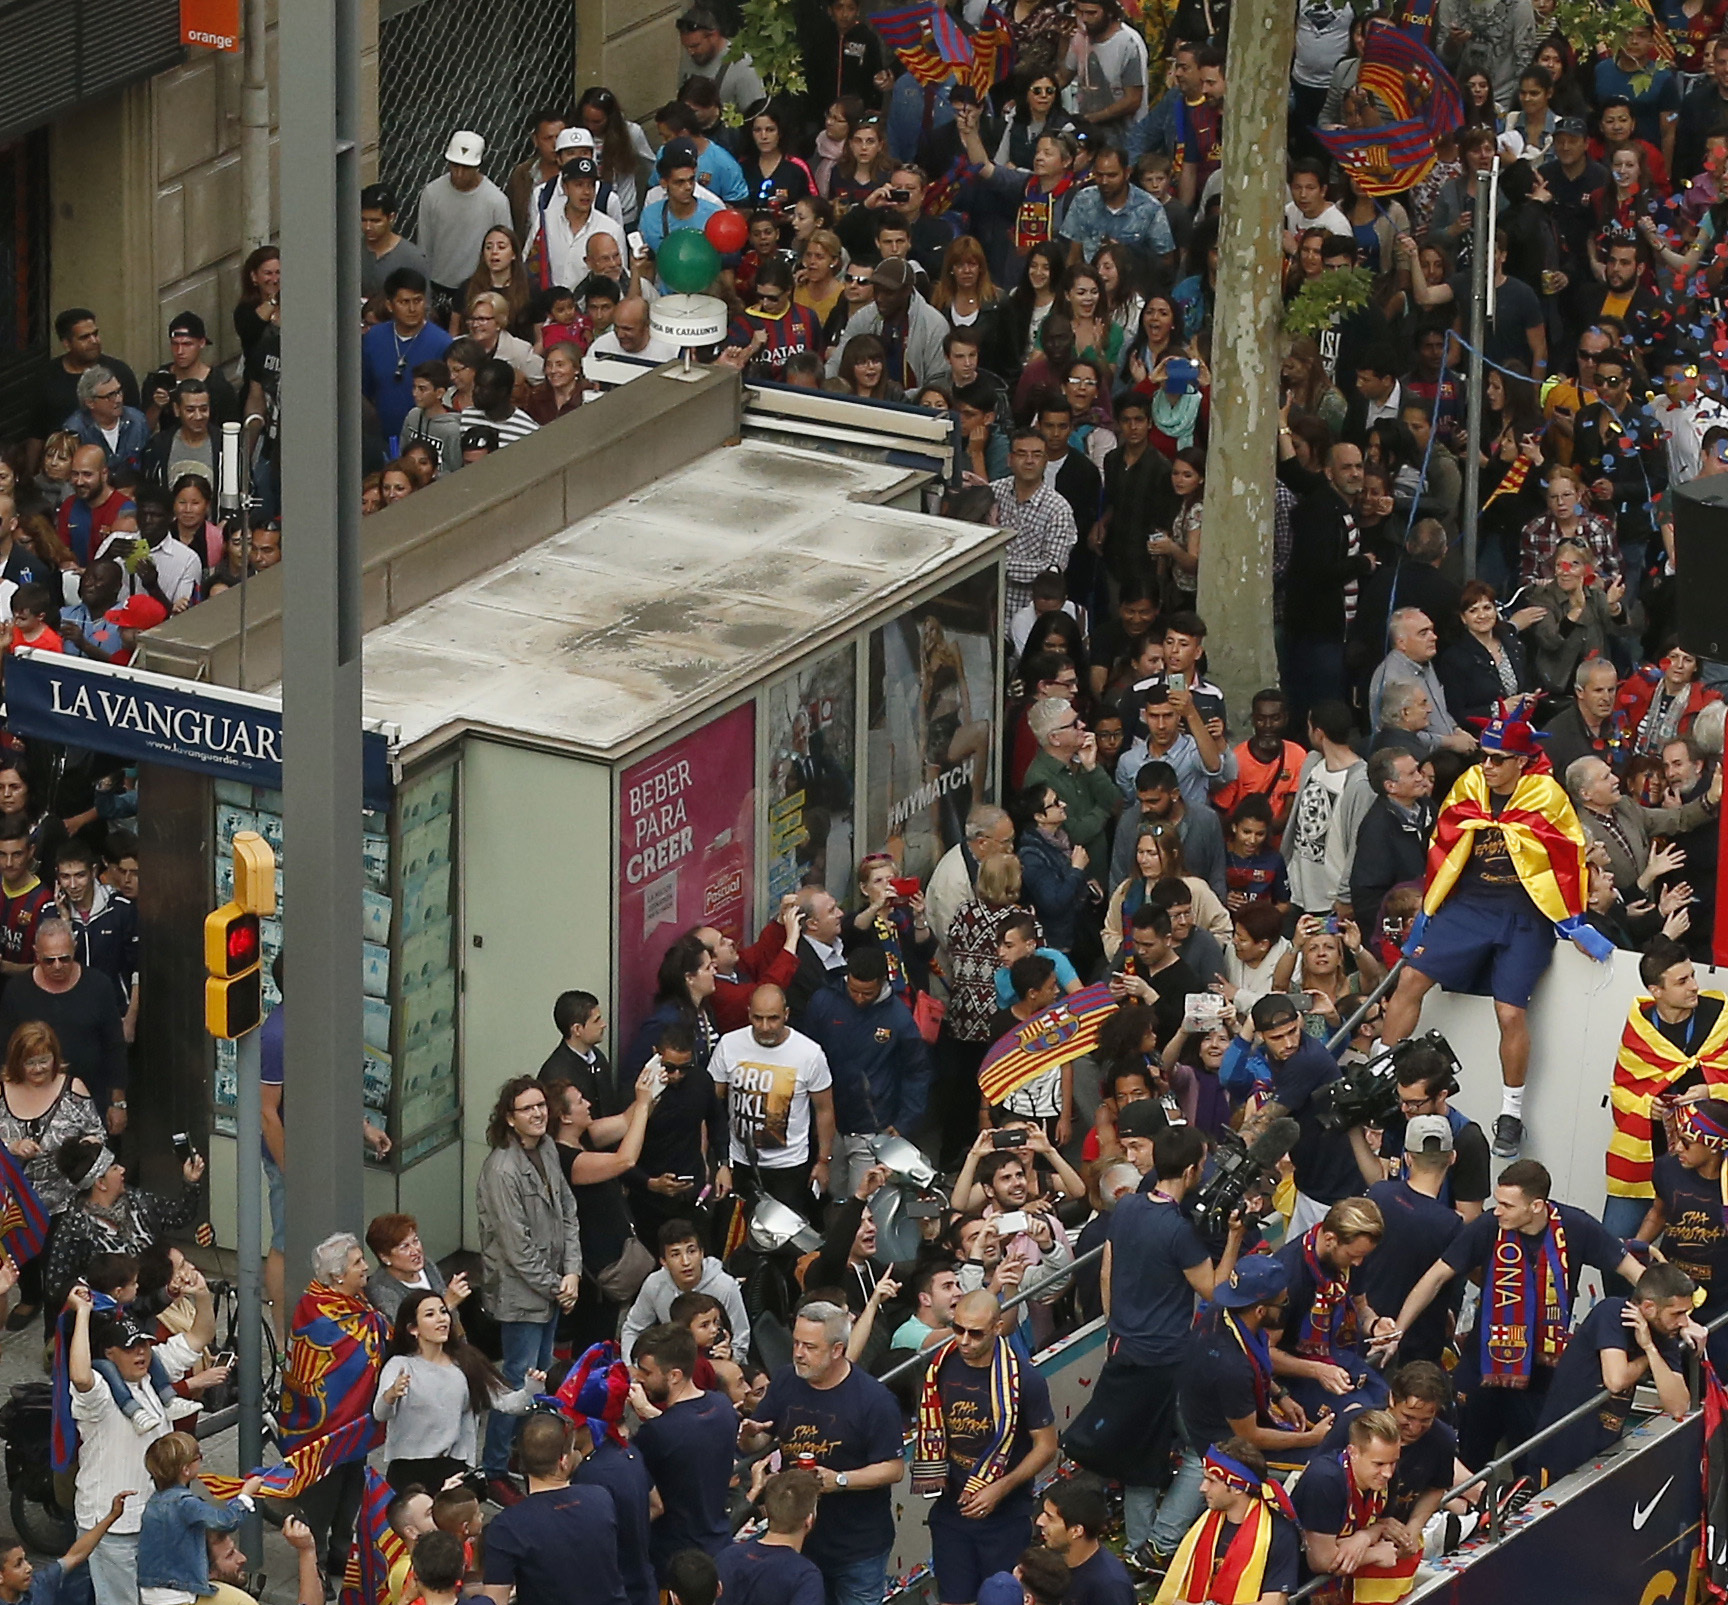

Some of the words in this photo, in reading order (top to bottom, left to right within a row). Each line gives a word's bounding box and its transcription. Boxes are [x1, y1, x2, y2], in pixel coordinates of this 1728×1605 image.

[188, 30, 233, 49] orange
[762, 343, 805, 363] QATAR
[50, 679, 90, 726] LA
[92, 687, 283, 763] VANGUAR
[628, 759, 692, 818] BEBER
[634, 799, 687, 847] PARA
[626, 825, 694, 885] CREER
[706, 878, 741, 906] Pascual
[731, 1066, 774, 1092] BRO
